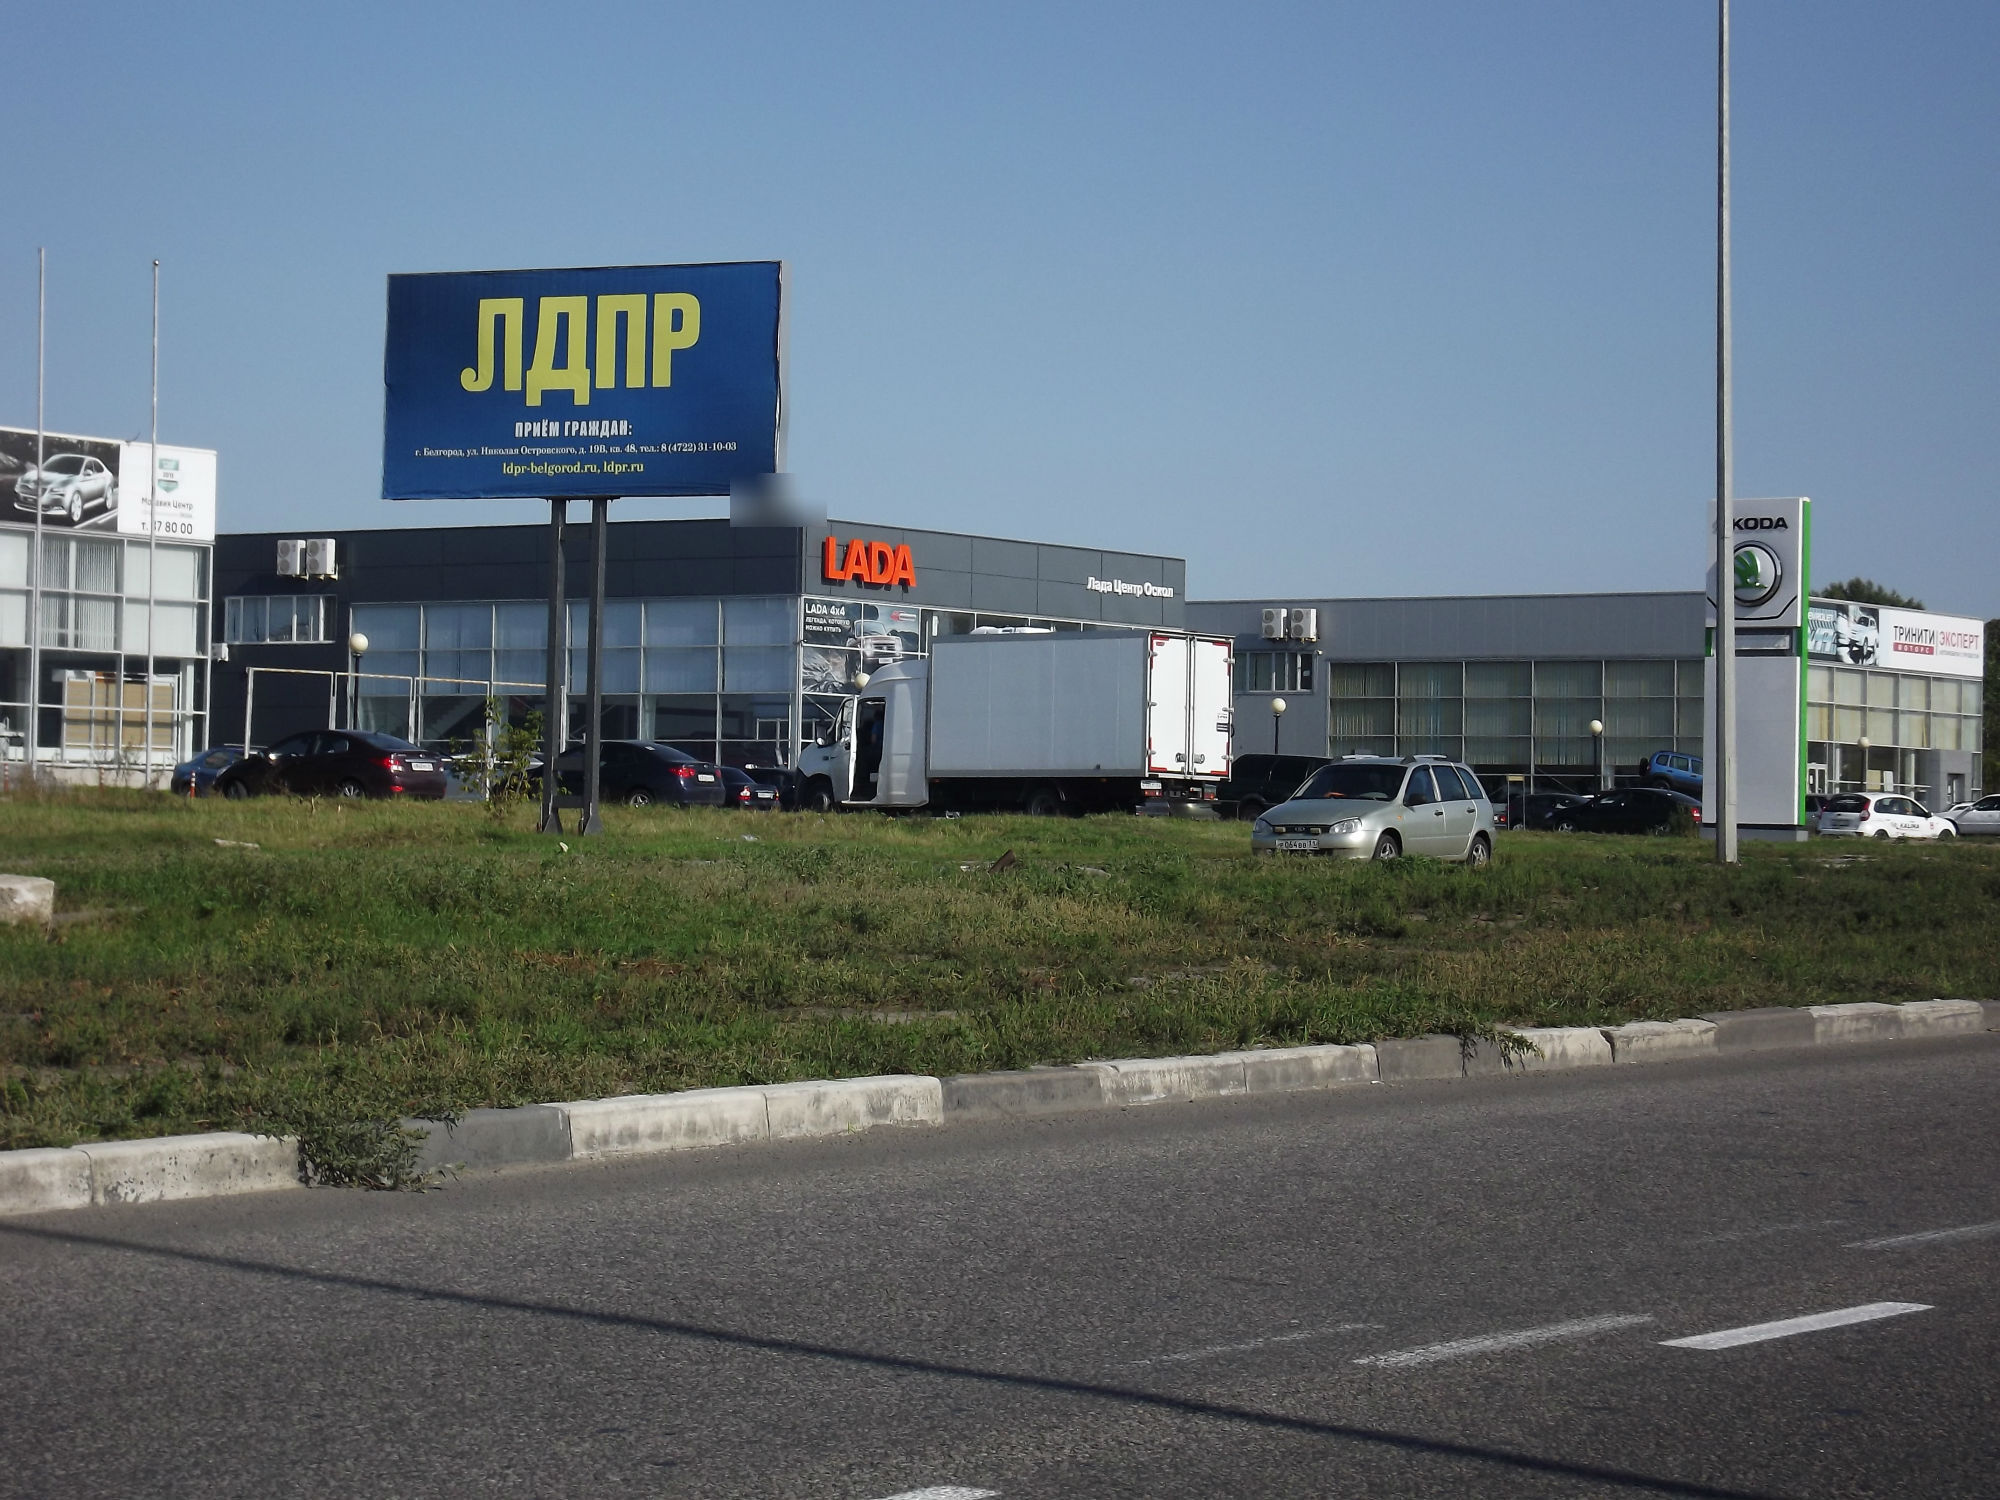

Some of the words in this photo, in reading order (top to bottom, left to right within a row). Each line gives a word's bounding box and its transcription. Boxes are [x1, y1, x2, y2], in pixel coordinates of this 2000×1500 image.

[460, 292, 701, 407] ЛДПР
[514, 419, 560, 437] ПРИЁМ
[564, 420, 633, 438] ГРАЖДАН:
[423, 447, 465, 458] Белгород,
[466, 448, 479, 458] ул.
[481, 446, 519, 456] Николая
[520, 445, 578, 456] Островского,
[625, 443, 638, 454] 48,
[668, 442, 696, 454] (4722)
[698, 441, 737, 452] 31-10-03
[503, 461, 600, 476] ldpr-belgorod.ru,
[603, 461, 644, 475] ldpr.ru
[165, 521, 178, 533] 80
[180, 522, 193, 535] 00
[1732, 517, 1788, 531] KODA
[824, 536, 917, 587] LADA
[1086, 576, 1112, 593] Лада
[1113, 579, 1142, 597] Центр
[1143, 582, 1174, 598] Оскол
[805, 603, 828, 615] LADA
[1893, 626, 1935, 644] ТРИНИТИ
[1939, 631, 1979, 649] ЭКСПЕРТ
